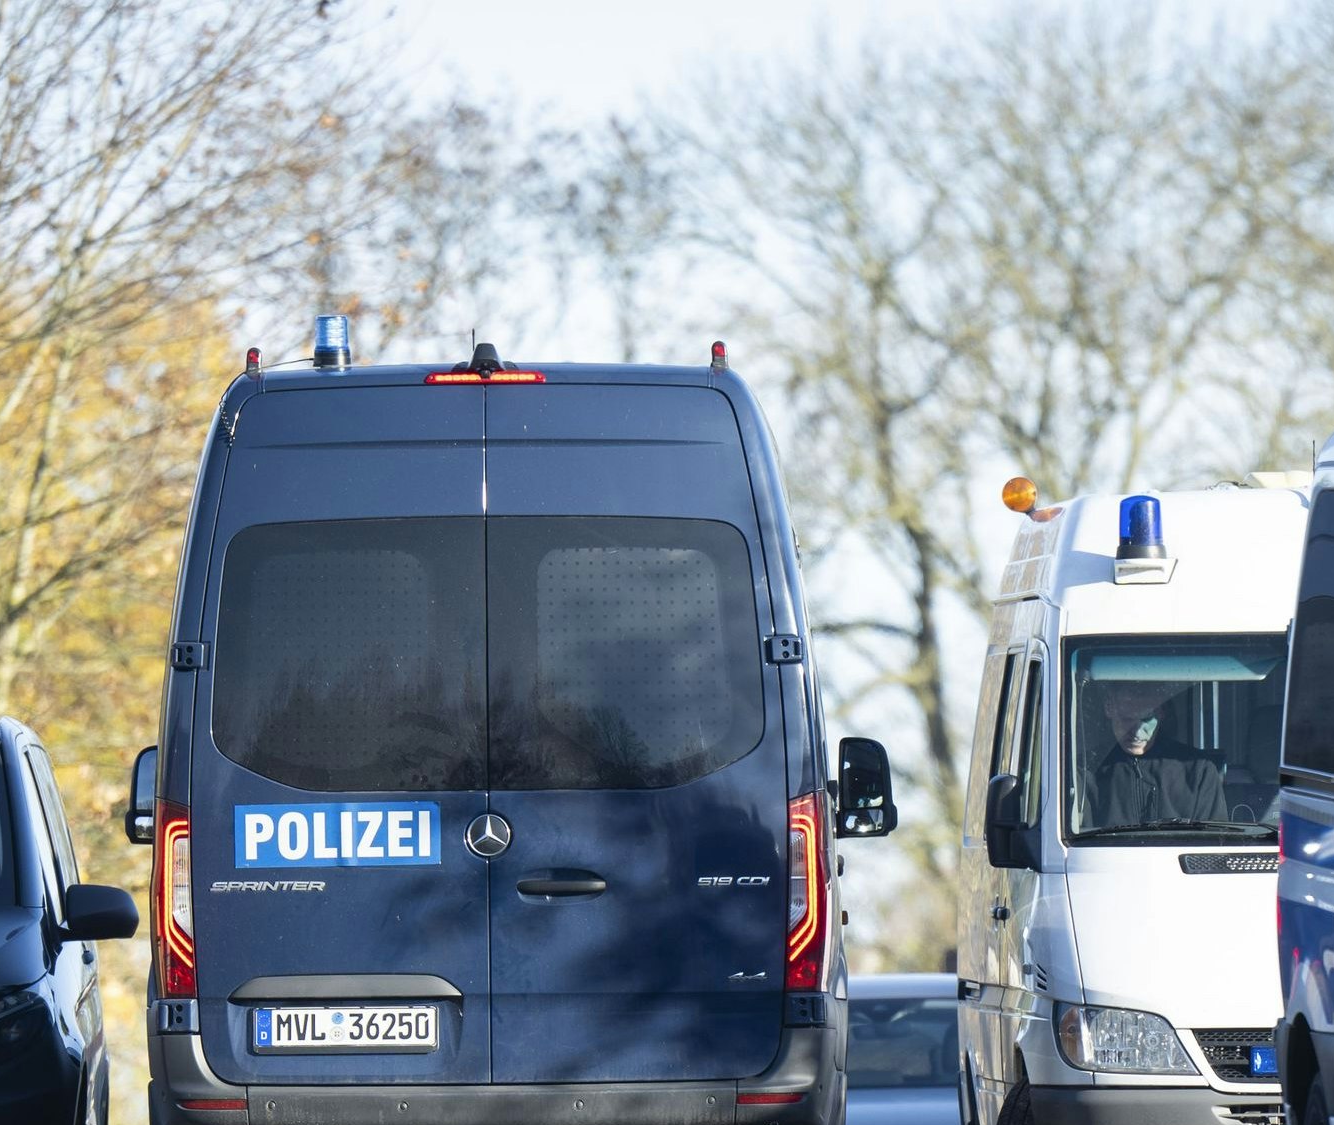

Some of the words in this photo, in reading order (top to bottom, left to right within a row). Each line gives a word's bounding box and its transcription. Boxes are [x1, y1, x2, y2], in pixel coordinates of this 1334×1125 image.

[244, 810, 431, 860] POLIZEI
[210, 881, 326, 892] SPRINTER
[697, 876, 733, 886] 519
[736, 876, 771, 886] CDI
[276, 1013, 326, 1041] MVL
[349, 1012, 429, 1040] 36250
[261, 1031, 267, 1040] D
